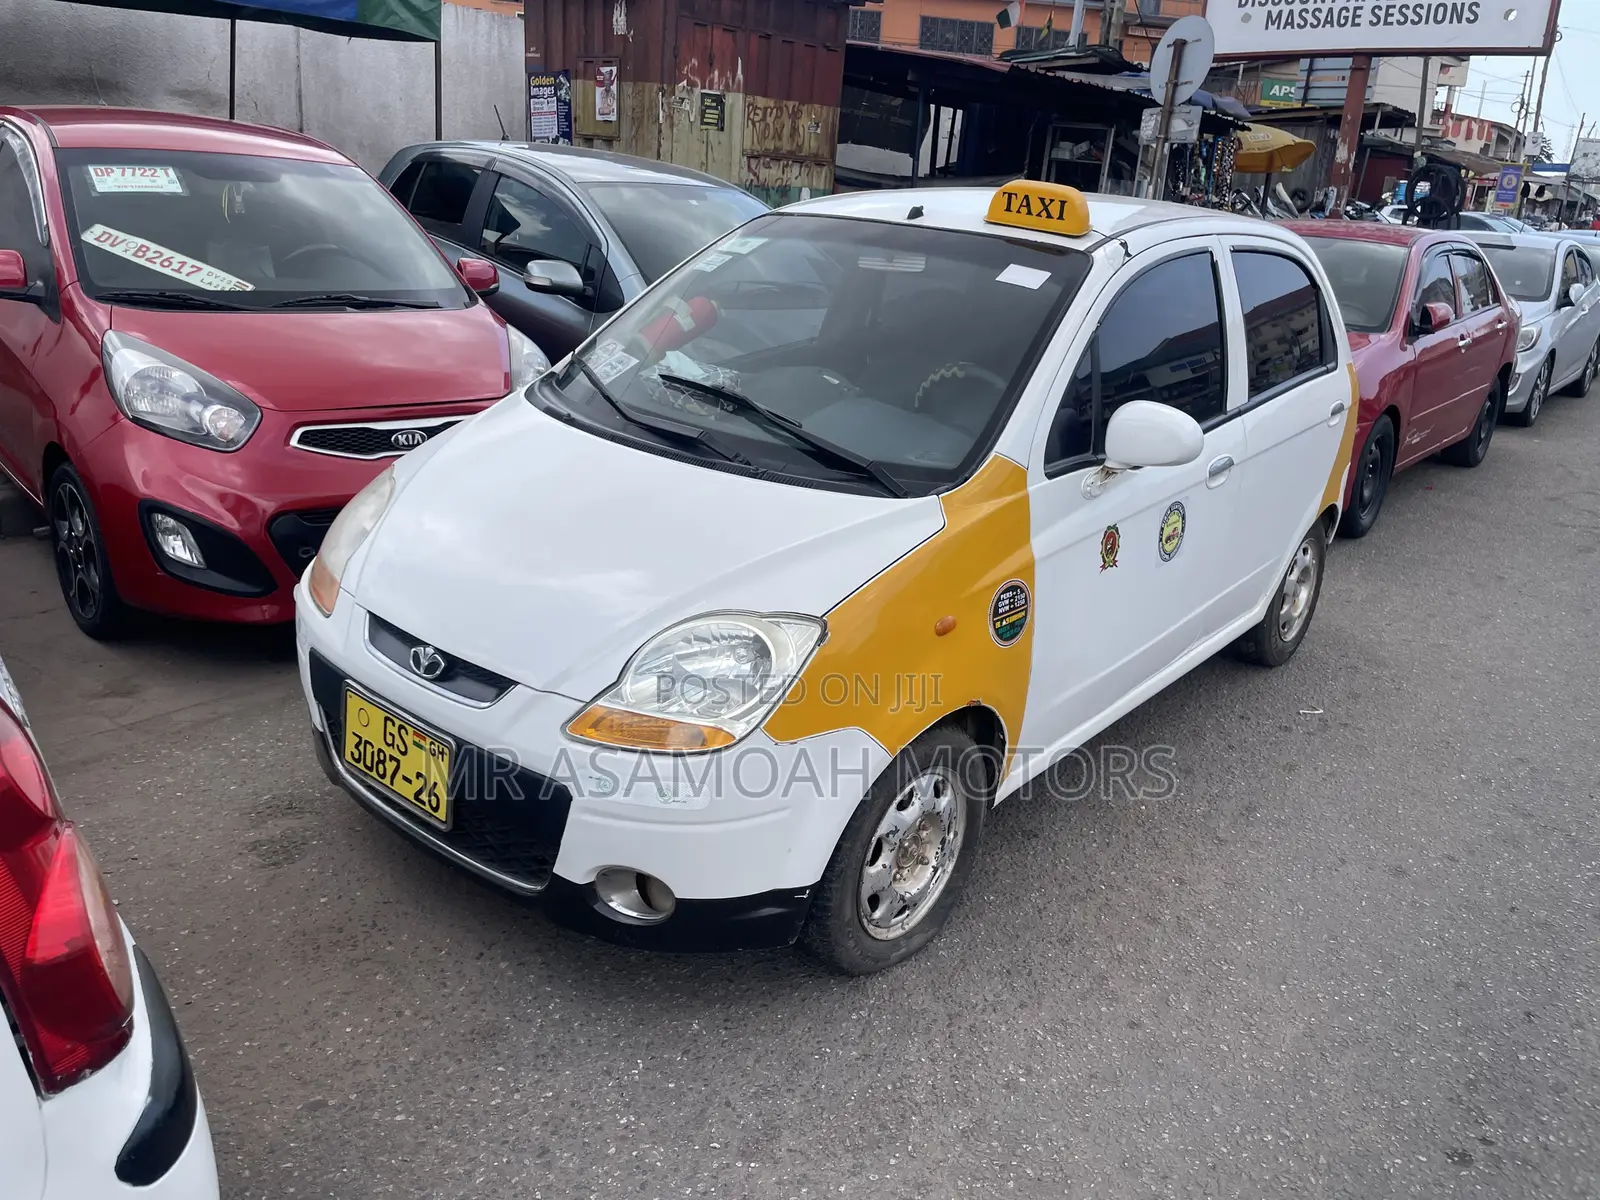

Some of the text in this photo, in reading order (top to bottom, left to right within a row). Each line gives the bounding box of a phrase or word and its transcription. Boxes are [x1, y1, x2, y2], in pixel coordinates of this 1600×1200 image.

[1264, 1, 1480, 31] MASSAGE SESSIONS
[531, 76, 555, 86] Golden
[530, 86, 555, 98] Images
[93, 167, 171, 178] DP 7722 T
[1002, 191, 1068, 222] TAXI
[94, 230, 127, 248] DV
[132, 243, 203, 278] B2617
[398, 433, 423, 446] KIA
[1001, 591, 1013, 600] PERS
[998, 599, 1010, 608] GVW
[998, 605, 1010, 614] NVW
[383, 715, 447, 763] GS GH
[350, 731, 441, 814] 3087-26
